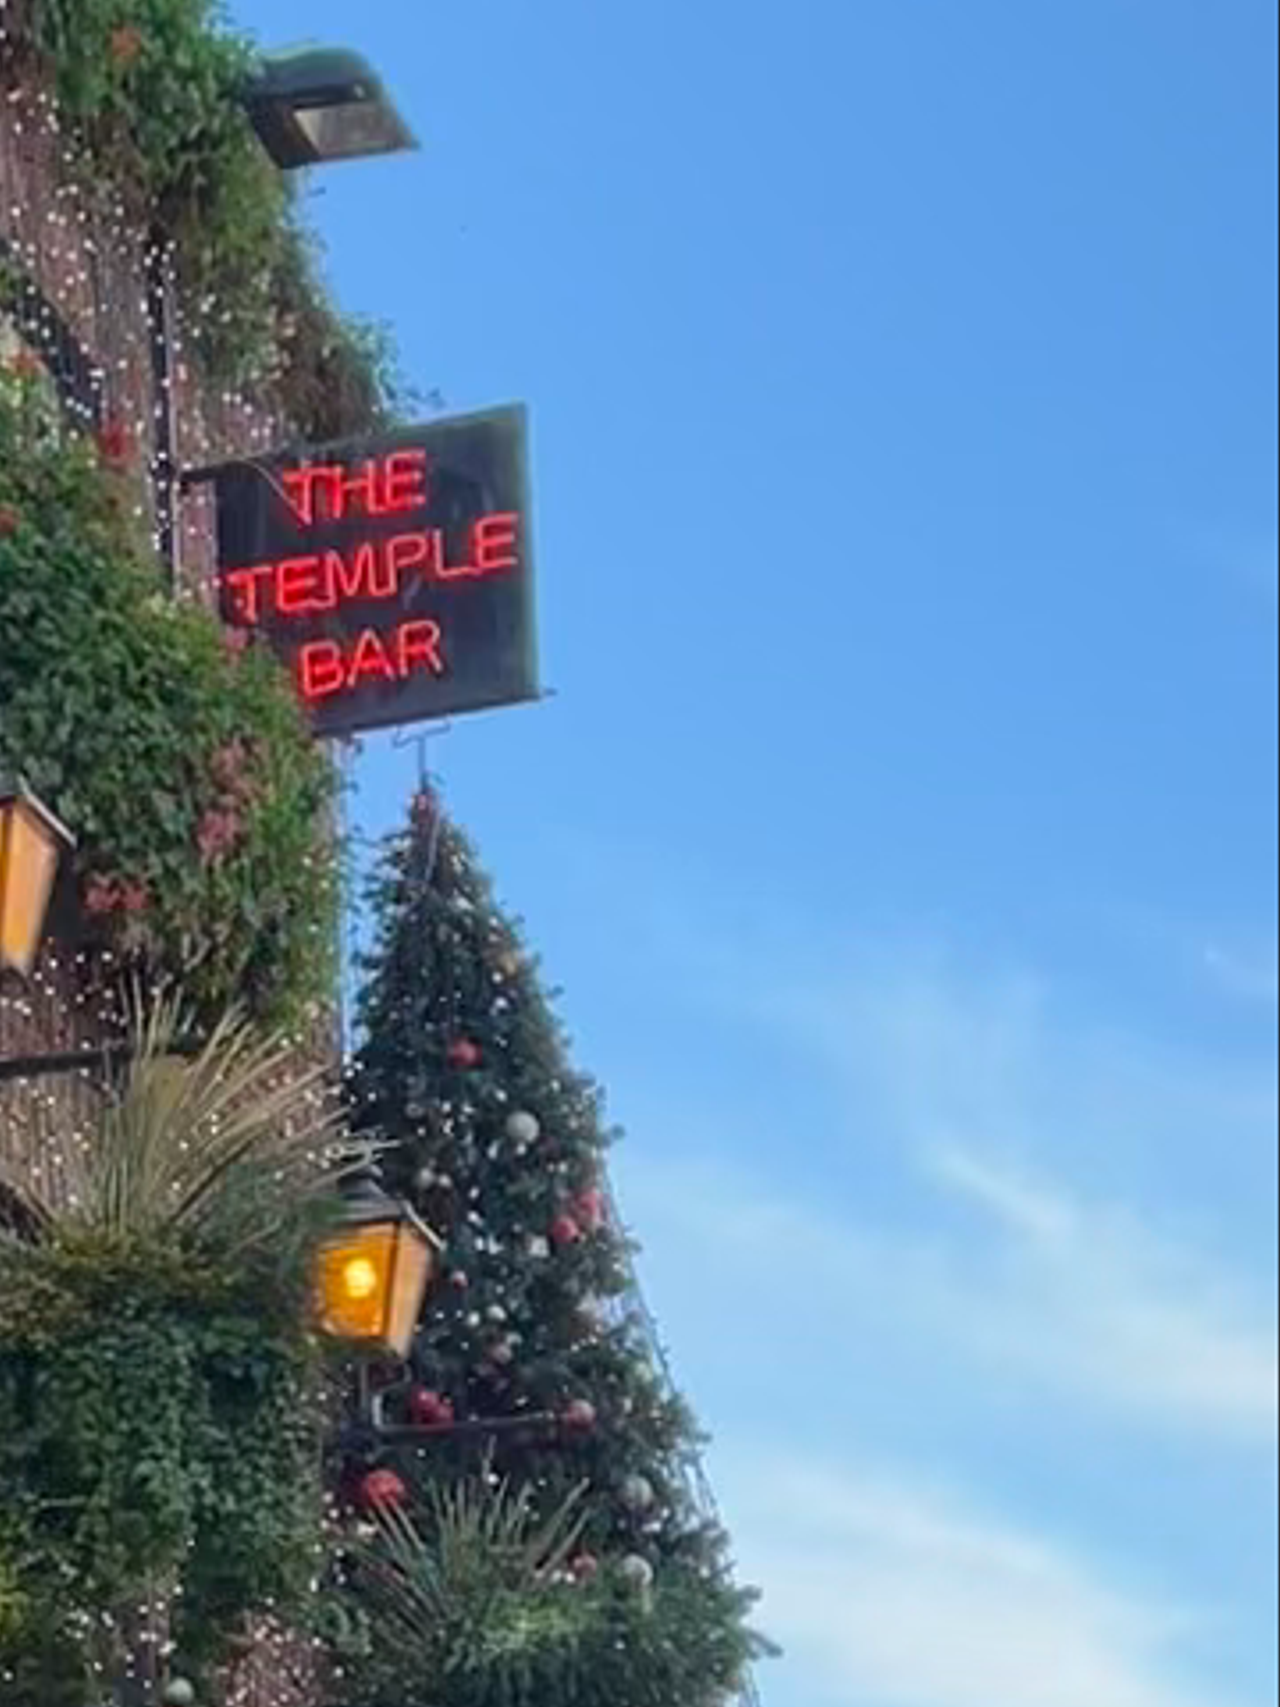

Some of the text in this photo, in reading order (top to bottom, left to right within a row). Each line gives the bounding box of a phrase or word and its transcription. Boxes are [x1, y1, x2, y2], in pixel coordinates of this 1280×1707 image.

[281, 446, 429, 526] THE
[225, 513, 521, 624] TEMPLE
[299, 618, 444, 696] BAR
